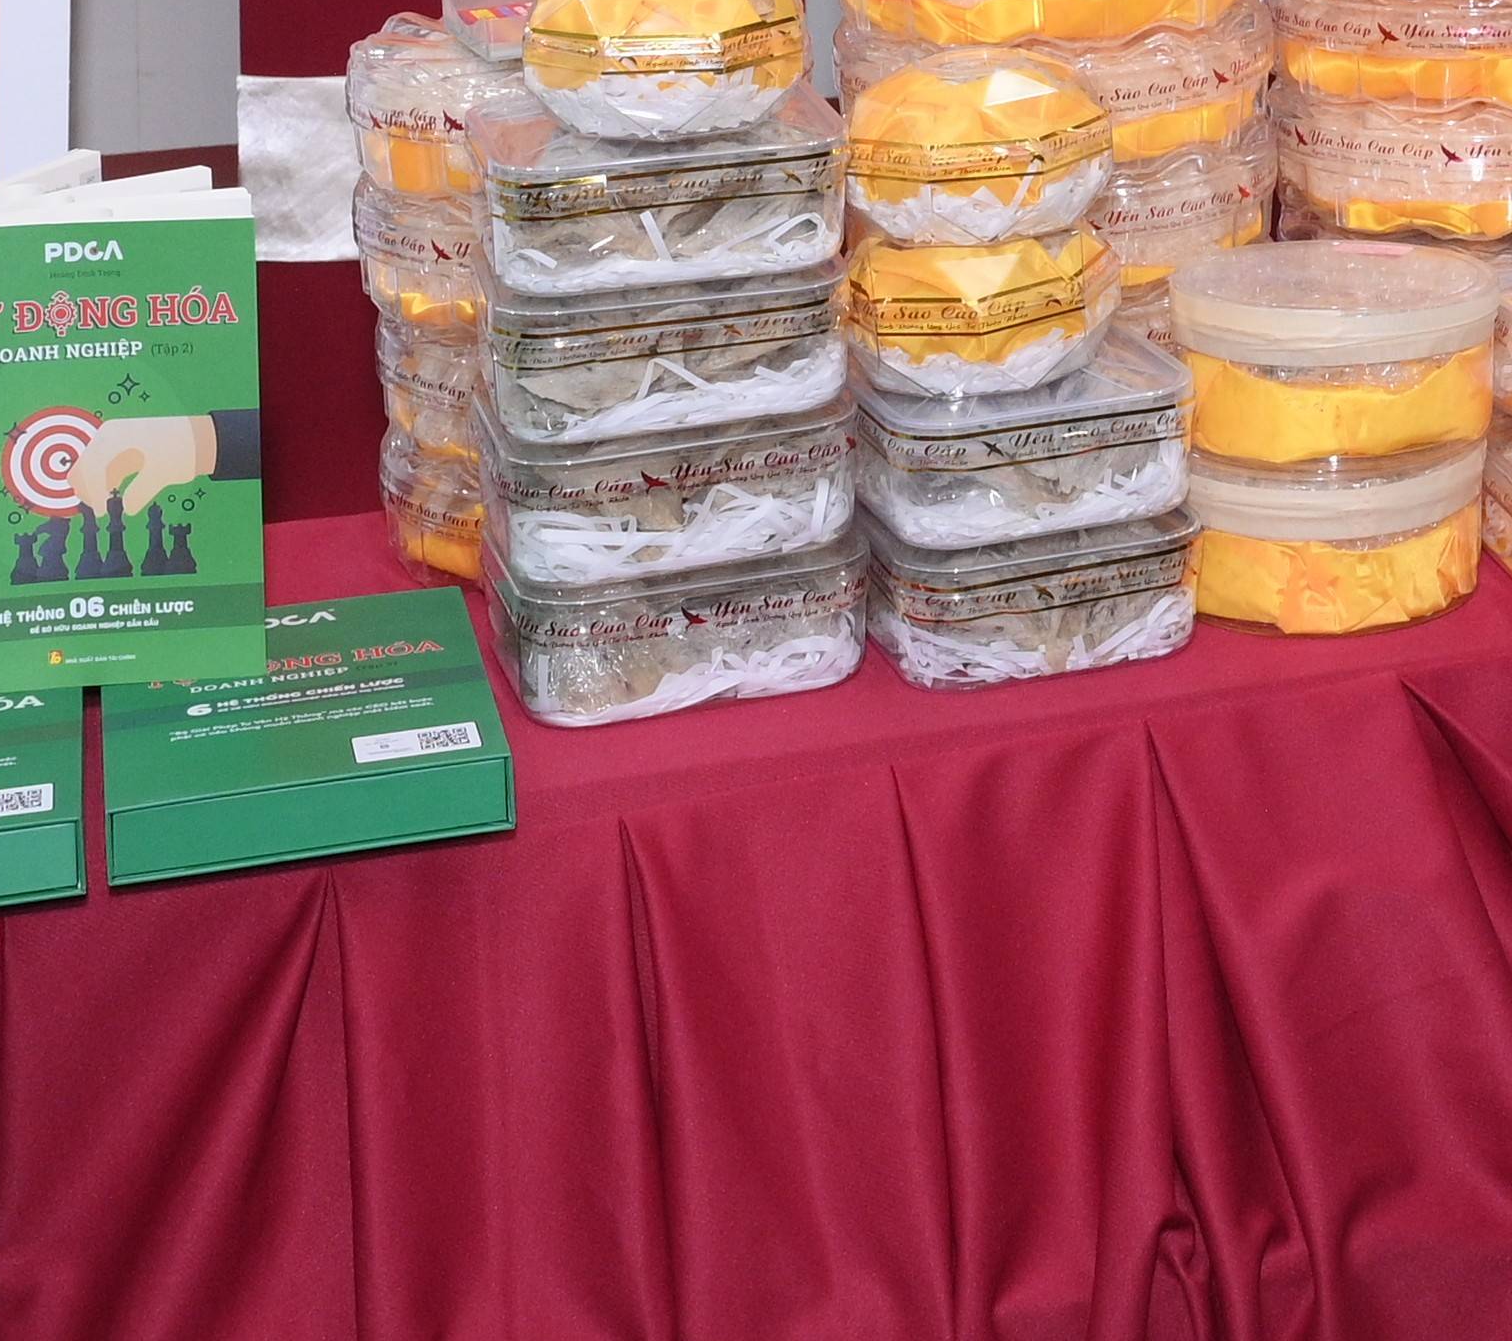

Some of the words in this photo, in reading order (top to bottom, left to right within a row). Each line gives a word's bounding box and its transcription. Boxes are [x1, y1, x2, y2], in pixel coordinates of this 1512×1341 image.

[146, 285, 239, 326] HÓA
[66, 339, 143, 360] NGHIỆP
[69, 596, 105, 619] 06
[155, 600, 195, 616] LƯỢC
[352, 640, 444, 662] HÓA
[190, 678, 263, 694] DOANH
[187, 703, 213, 717] 6
